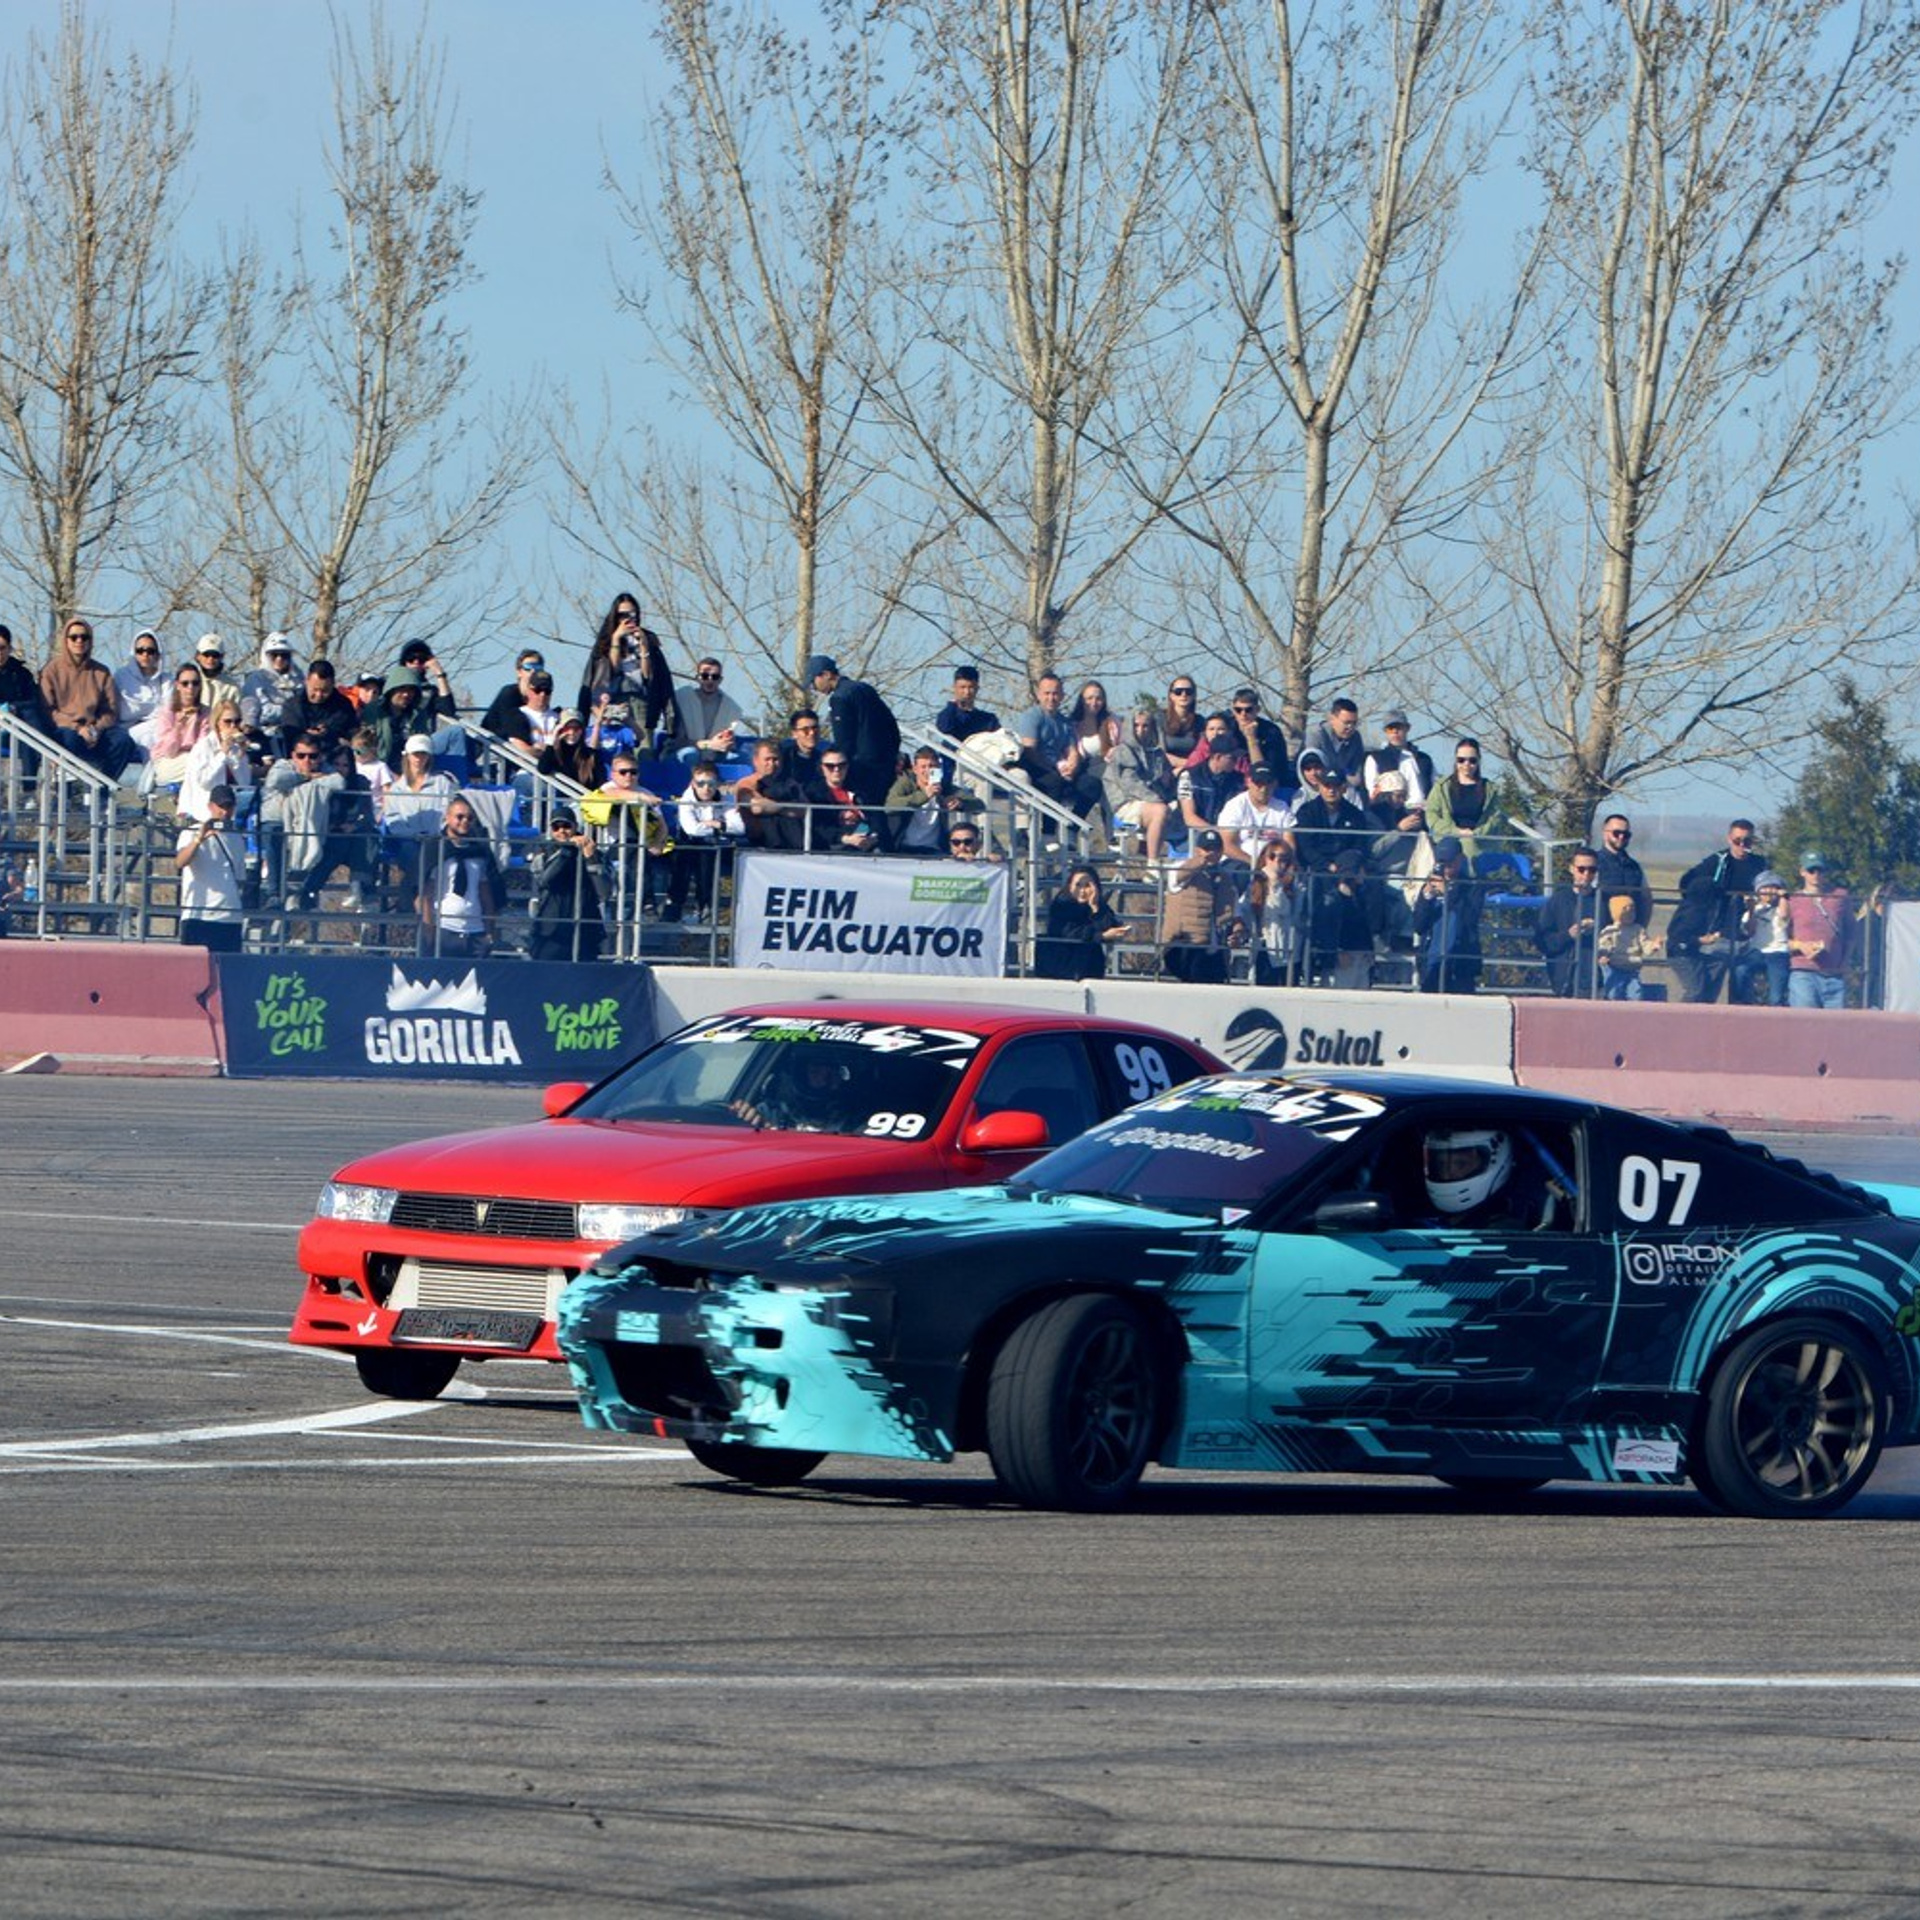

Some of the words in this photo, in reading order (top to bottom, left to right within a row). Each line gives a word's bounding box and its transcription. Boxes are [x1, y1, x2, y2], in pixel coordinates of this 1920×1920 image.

[764, 887, 858, 920] EFIM
[762, 920, 984, 958] EVACUATOR
[265, 971, 306, 1001] IT'S
[255, 996, 328, 1029] YOUR
[543, 998, 620, 1032] YOUR
[270, 1025, 328, 1056] CALL
[364, 1016, 522, 1065] GORILLA
[555, 1026, 622, 1051] MOVE
[1114, 1042, 1172, 1100] 99
[863, 1111, 926, 1138] 99
[1618, 1154, 1702, 1226] 07
[1661, 1244, 1742, 1263] IRON
